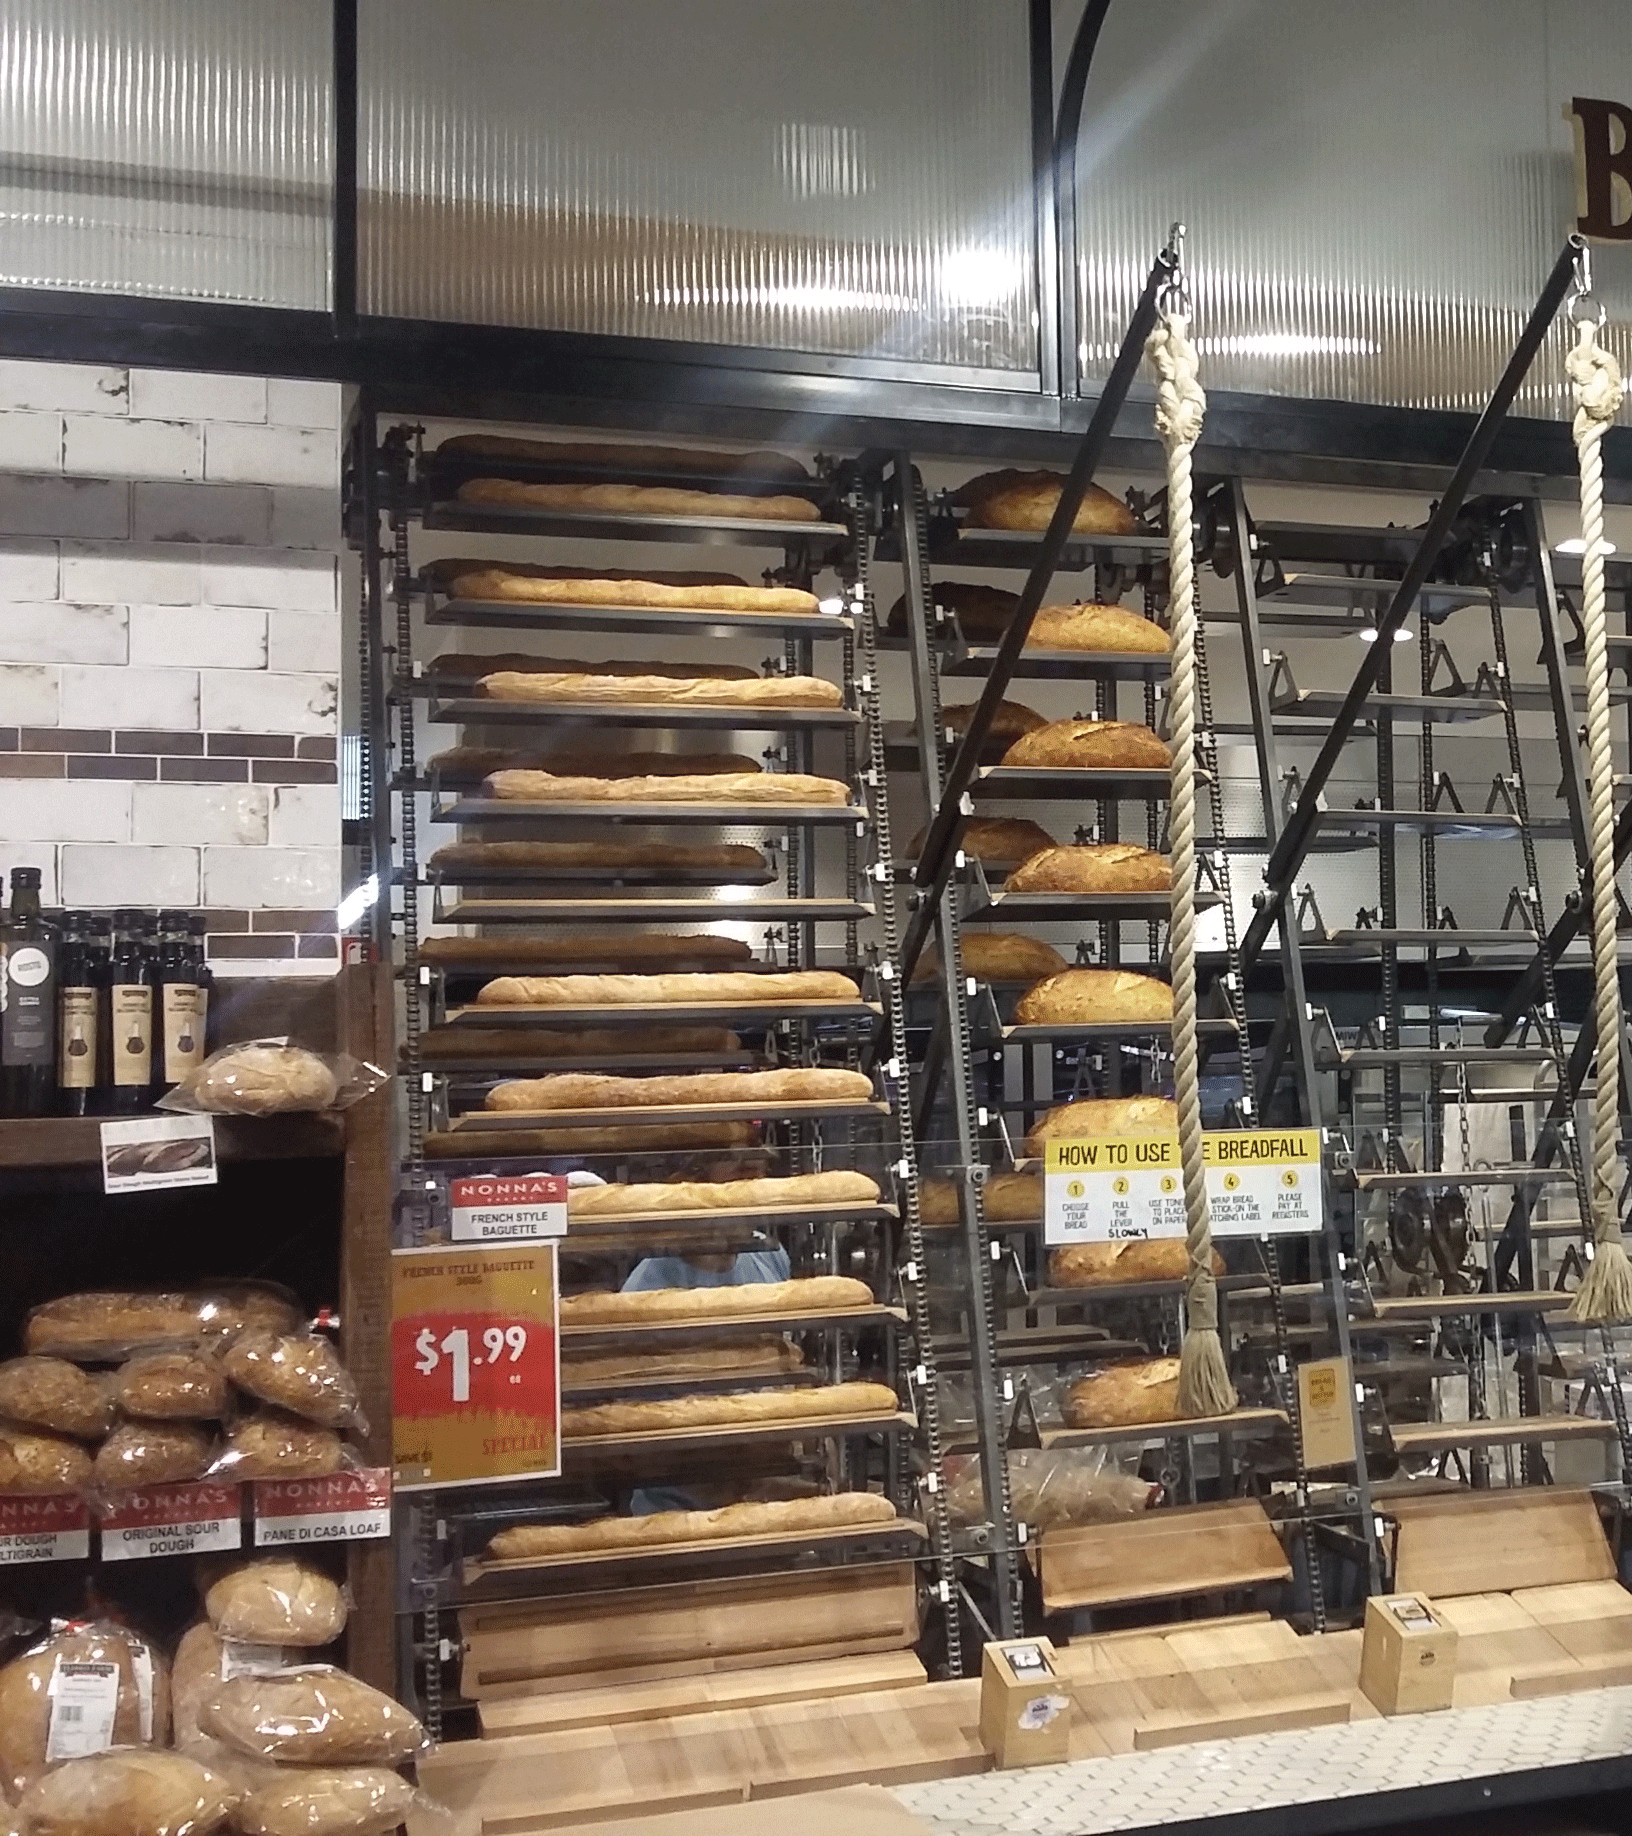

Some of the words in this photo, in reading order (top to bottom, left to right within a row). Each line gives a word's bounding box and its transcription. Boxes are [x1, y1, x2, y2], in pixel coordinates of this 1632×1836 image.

[1059, 1145, 1098, 1165] HOW
[1105, 1144, 1128, 1164] TO
[1136, 1143, 1170, 1162] USE
[1218, 1138, 1308, 1160] BREADFALL
[1165, 1179, 1172, 1190] 3
[1287, 1174, 1294, 1185] 5
[461, 1182, 558, 1196] NONNA'S
[1118, 1181, 1124, 1192] 2
[1278, 1193, 1302, 1201] PLEASE
[1112, 1201, 1129, 1209] PULL
[1278, 1202, 1289, 1210] PAY
[1294, 1201, 1302, 1209] AT
[471, 1213, 514, 1224] FRENCH
[516, 1211, 548, 1222] STYLE
[1115, 1210, 1127, 1218] THE
[1241, 1212, 1261, 1220] LABEL
[1110, 1219, 1132, 1227] LEVER
[482, 1224, 537, 1236] BAGUETTE
[1108, 1228, 1148, 1239] SLOWLY
[414, 1325, 527, 1402] $1.99
[123, 1526, 181, 1541] ORIGINAL
[185, 1522, 220, 1535] SOUR
[264, 1529, 296, 1541] PANE
[300, 1527, 311, 1539] DI
[314, 1525, 346, 1537] CASA
[350, 1522, 381, 1535] LOAF
[16, 1534, 57, 1547] DOUGH
[150, 1538, 194, 1553] DOUGH
